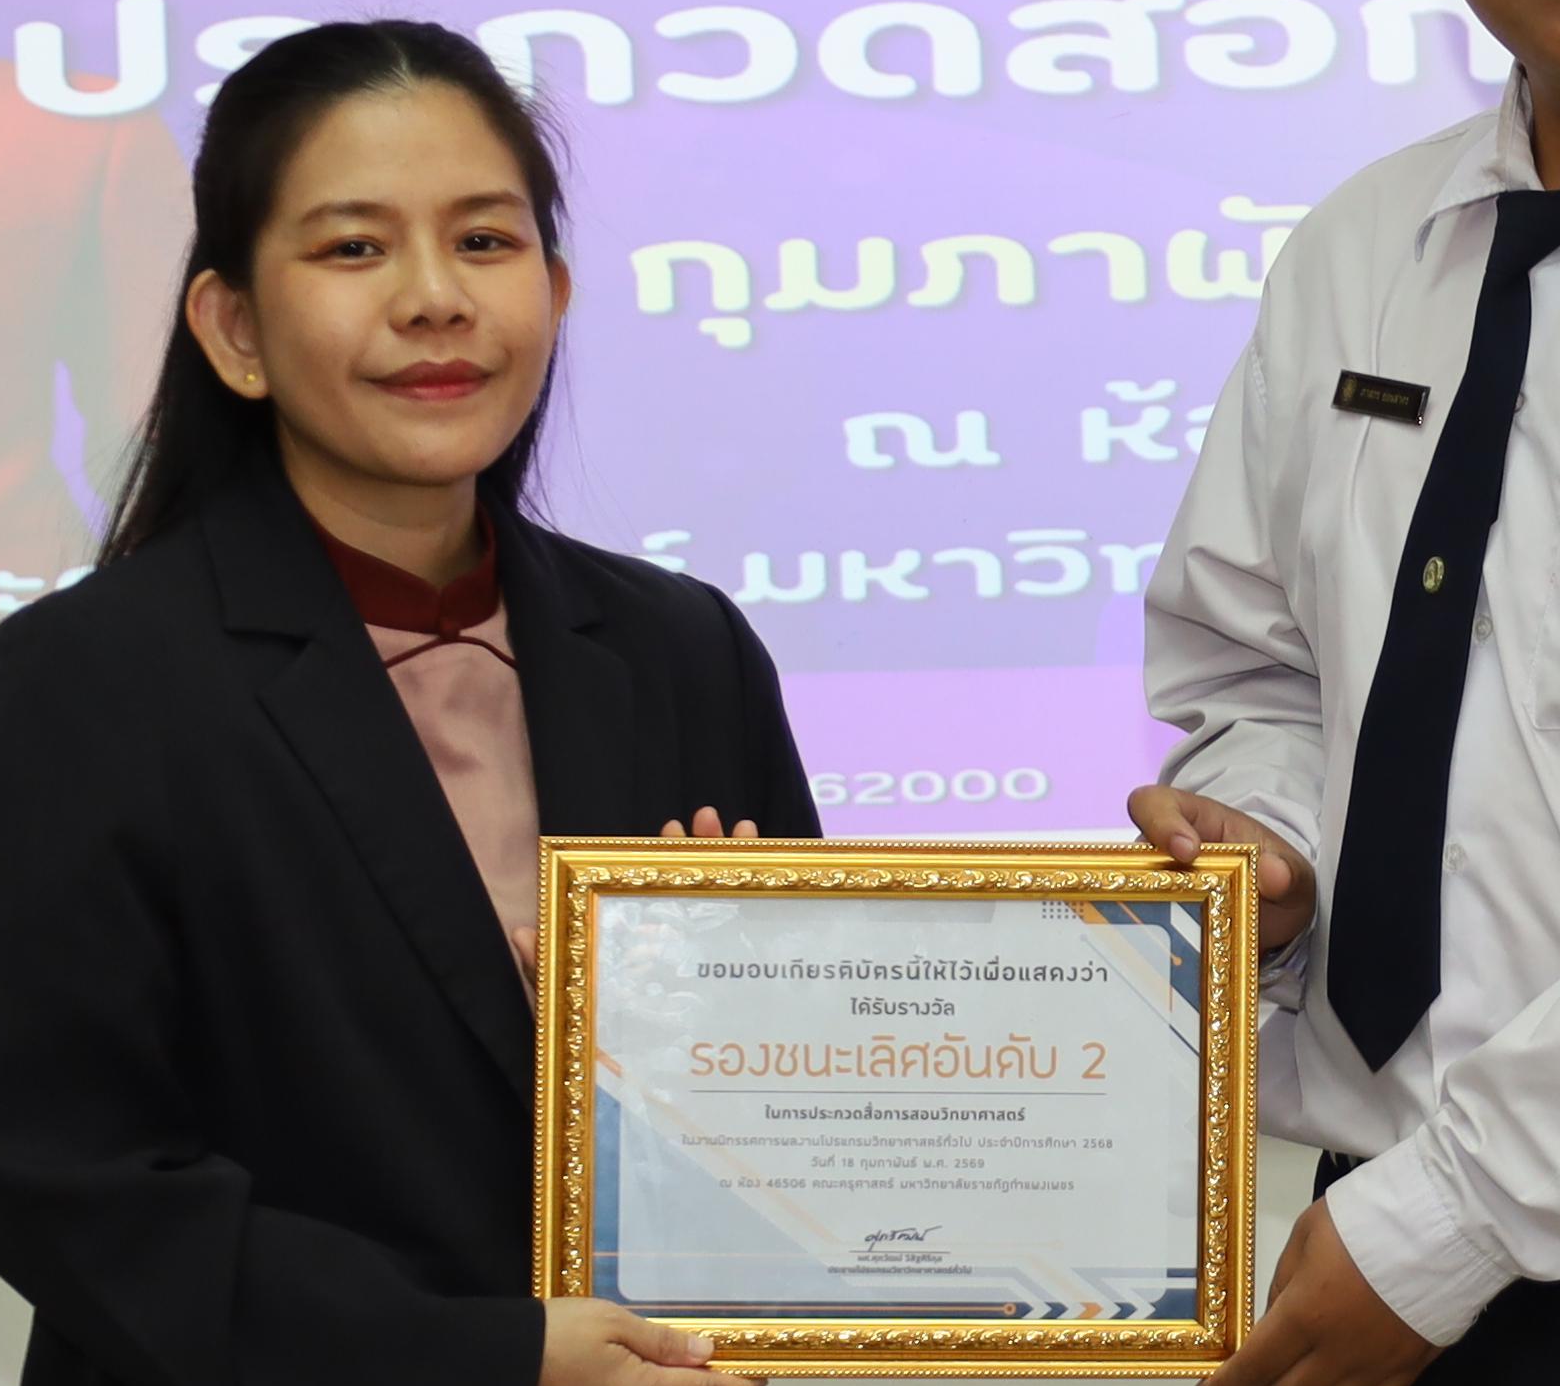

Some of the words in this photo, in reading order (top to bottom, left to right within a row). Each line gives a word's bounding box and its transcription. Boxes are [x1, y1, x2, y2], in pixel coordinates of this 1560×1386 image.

[844, 409, 1002, 469] ณ
[810, 767, 1052, 806] 62000
[696, 954, 1109, 984] ขอมอบเกียรติบัตรนี้ให้ไว้เพื่อแสดงว่า
[849, 996, 956, 1017] ได้รับรางวัล
[689, 1031, 1058, 1080] รองชนะเลิศอันดับ
[1081, 1042, 1108, 1080] 2
[764, 1102, 1027, 1122] ในการประกวดสื่อการสอนวิทยาศาสตร์
[1082, 1138, 1114, 1150] 2568
[954, 1158, 986, 1169] 2569
[766, 1179, 807, 1190] 46506
